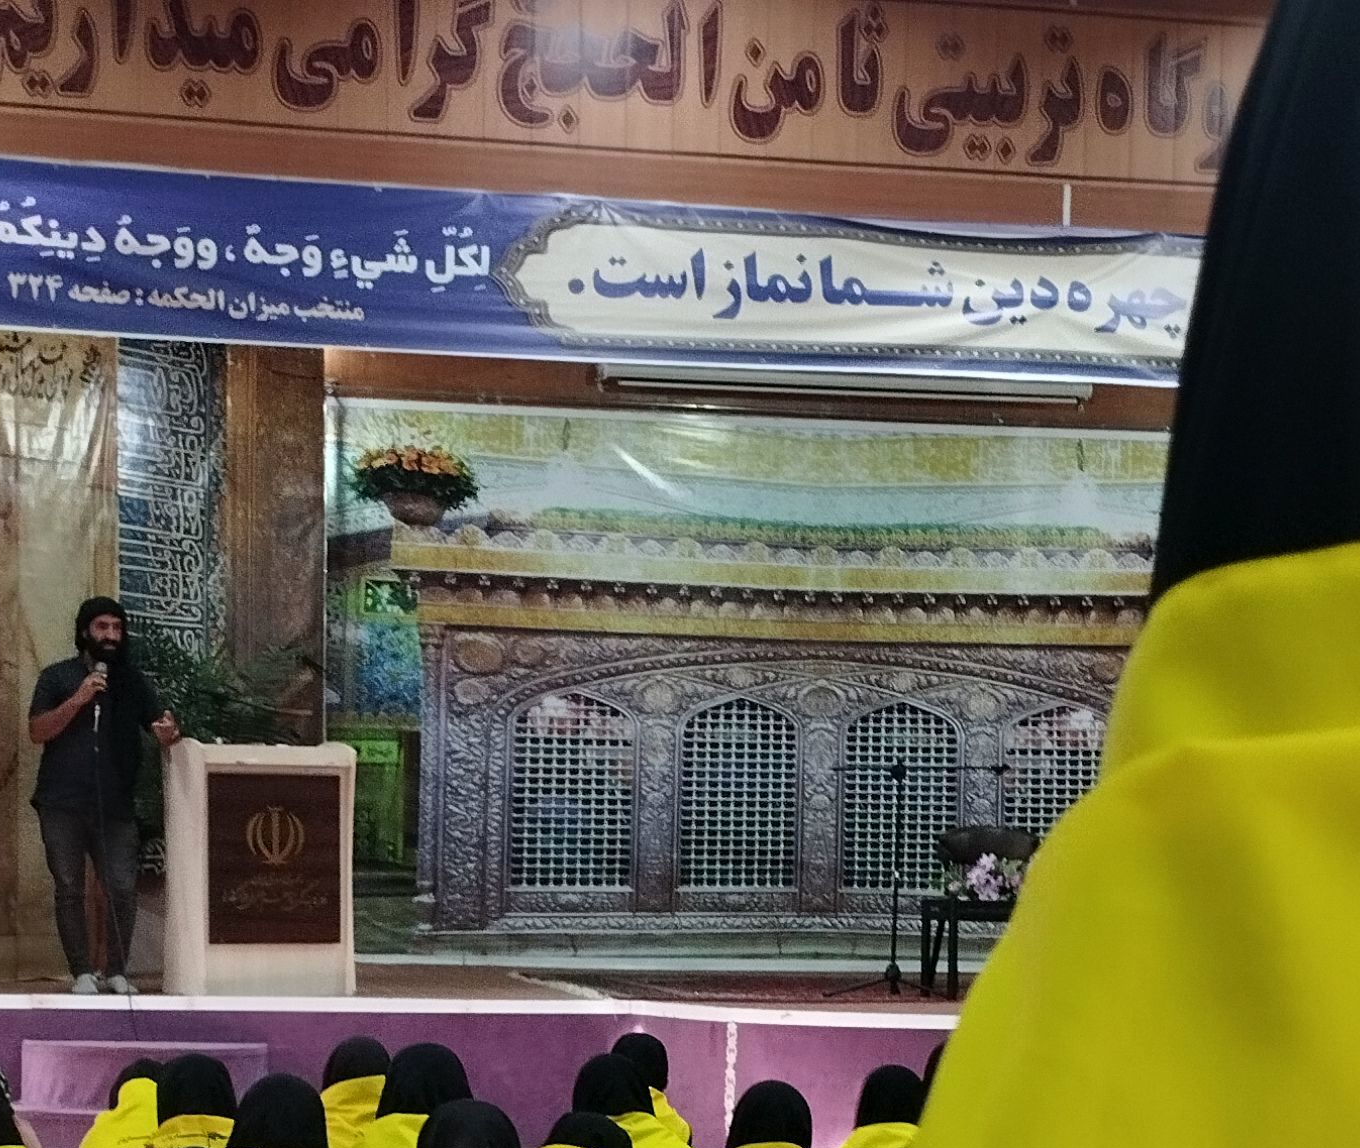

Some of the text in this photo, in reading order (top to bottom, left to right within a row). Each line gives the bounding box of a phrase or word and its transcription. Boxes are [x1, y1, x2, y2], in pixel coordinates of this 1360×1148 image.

[272, 0, 494, 123] گرامی
[497, 0, 723, 134] الحجج
[729, 0, 889, 144] ثامن
[892, 24, 1084, 167] تربیتی
[1095, 31, 1234, 174] وگاه
[7, 271, 64, 302] ۳۲۴
[68, 281, 131, 306] صفحه
[229, 291, 289, 322] میزان
[294, 296, 365, 322] منتخب
[568, 248, 1187, 340] چهره دین شما نماز است.
